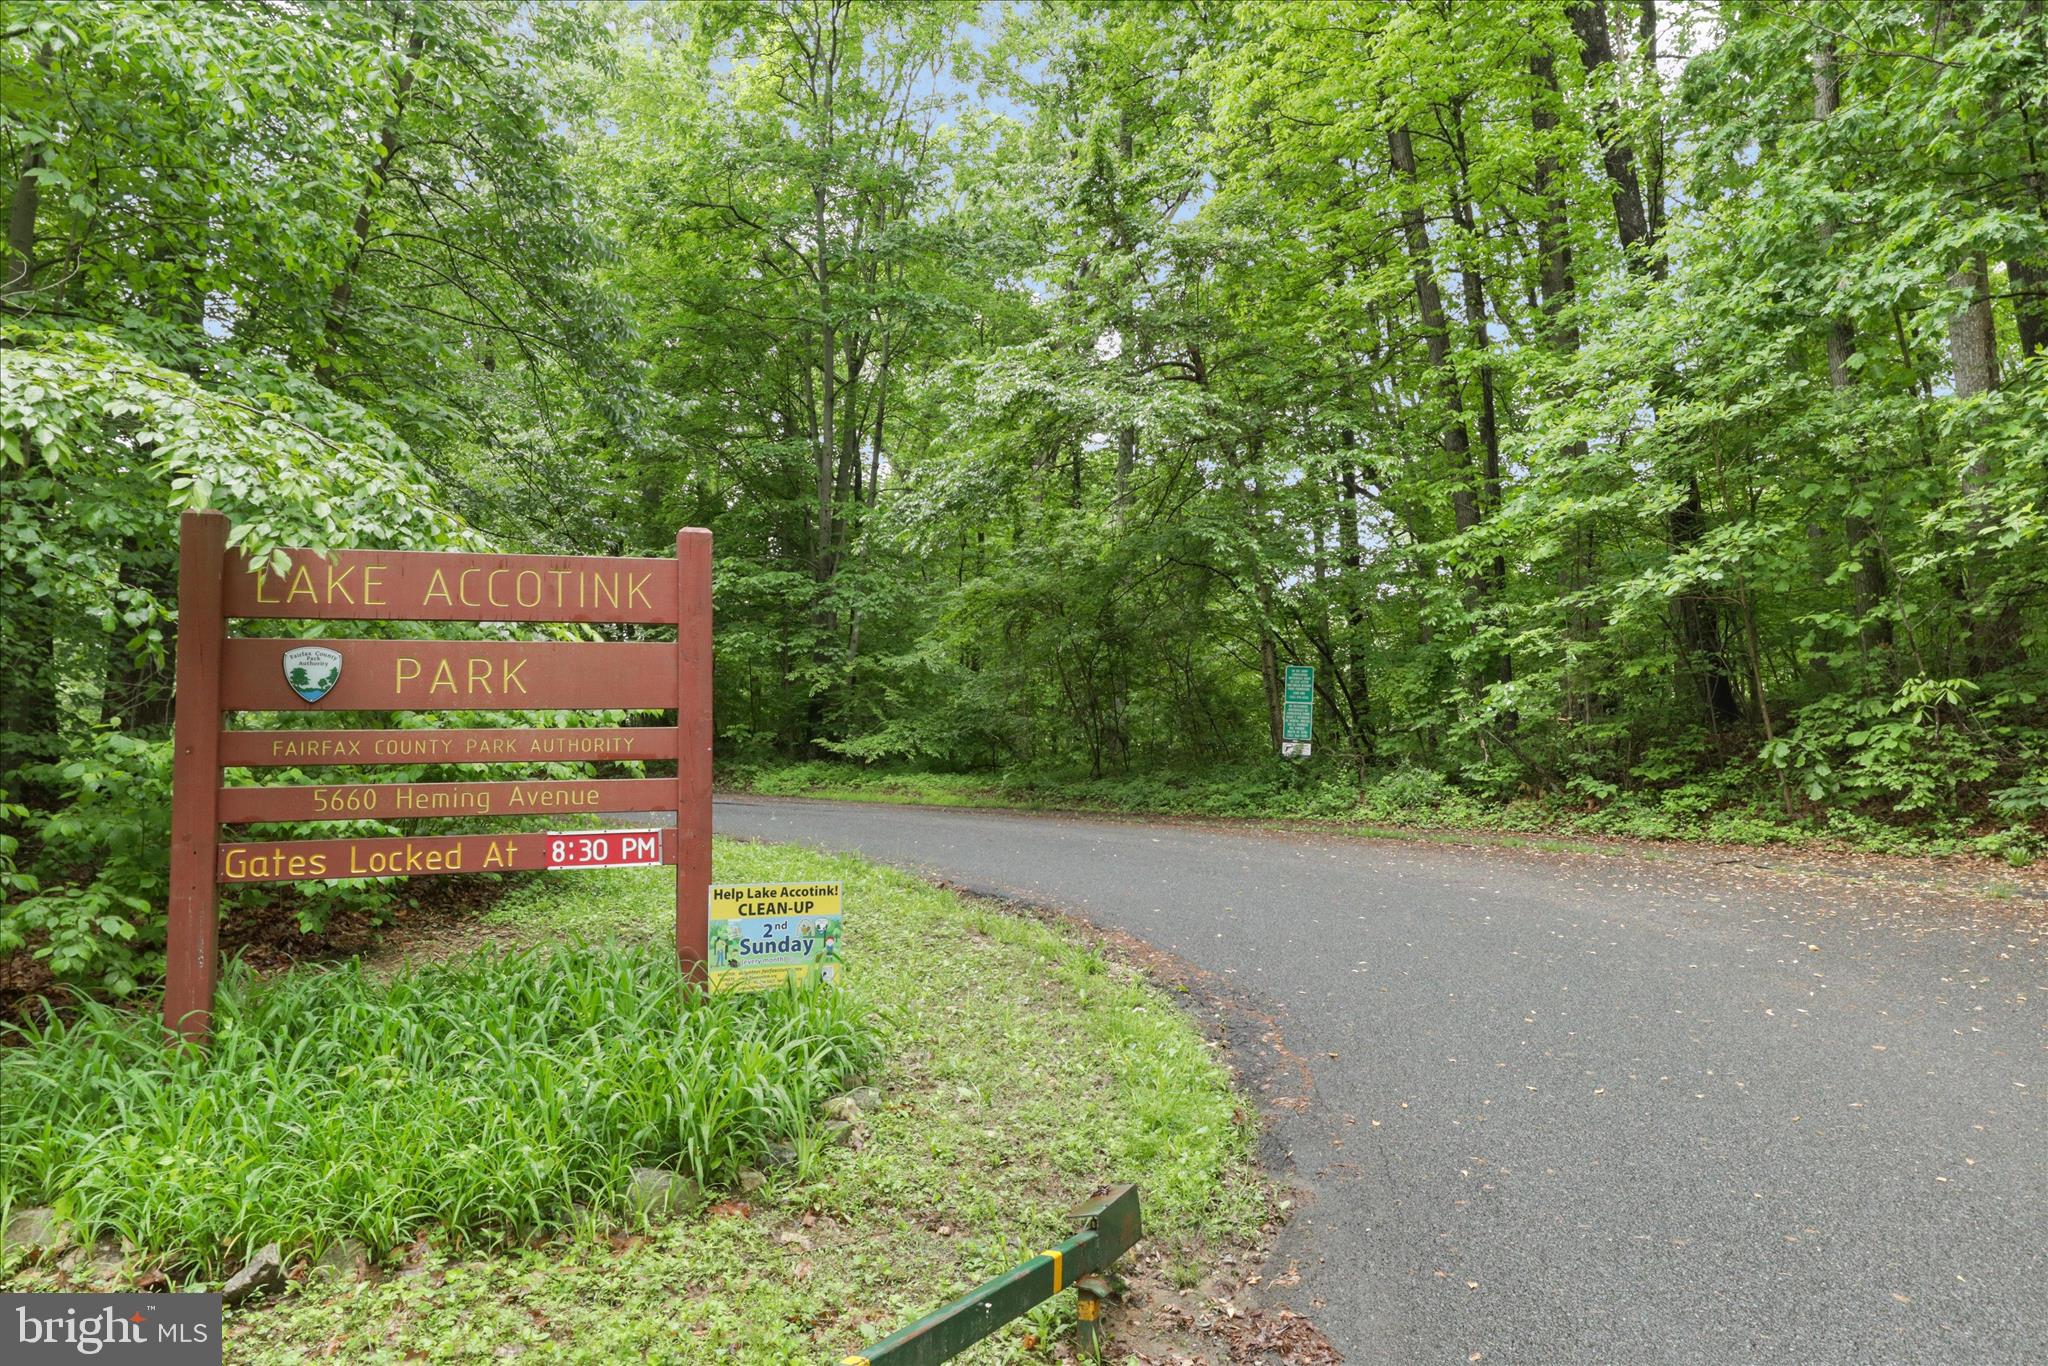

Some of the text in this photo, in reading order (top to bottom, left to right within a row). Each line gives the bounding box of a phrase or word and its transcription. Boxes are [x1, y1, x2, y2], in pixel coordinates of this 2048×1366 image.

[256, 564, 654, 610] LAKE ACCOTINK
[395, 657, 529, 695] PARK
[272, 736, 635, 757] FAIRFAX COUNTY PARK AUTHORITY
[312, 786, 601, 814] 5660 Heming Avenue
[224, 840, 519, 879] Gates Locked At
[551, 836, 656, 864] 8:30 PM
[713, 885, 839, 902] Help Lake Accotink!
[738, 901, 815, 917] CLEAN-UP
[762, 921, 788, 938] 2nd
[739, 935, 815, 956] Sunday
